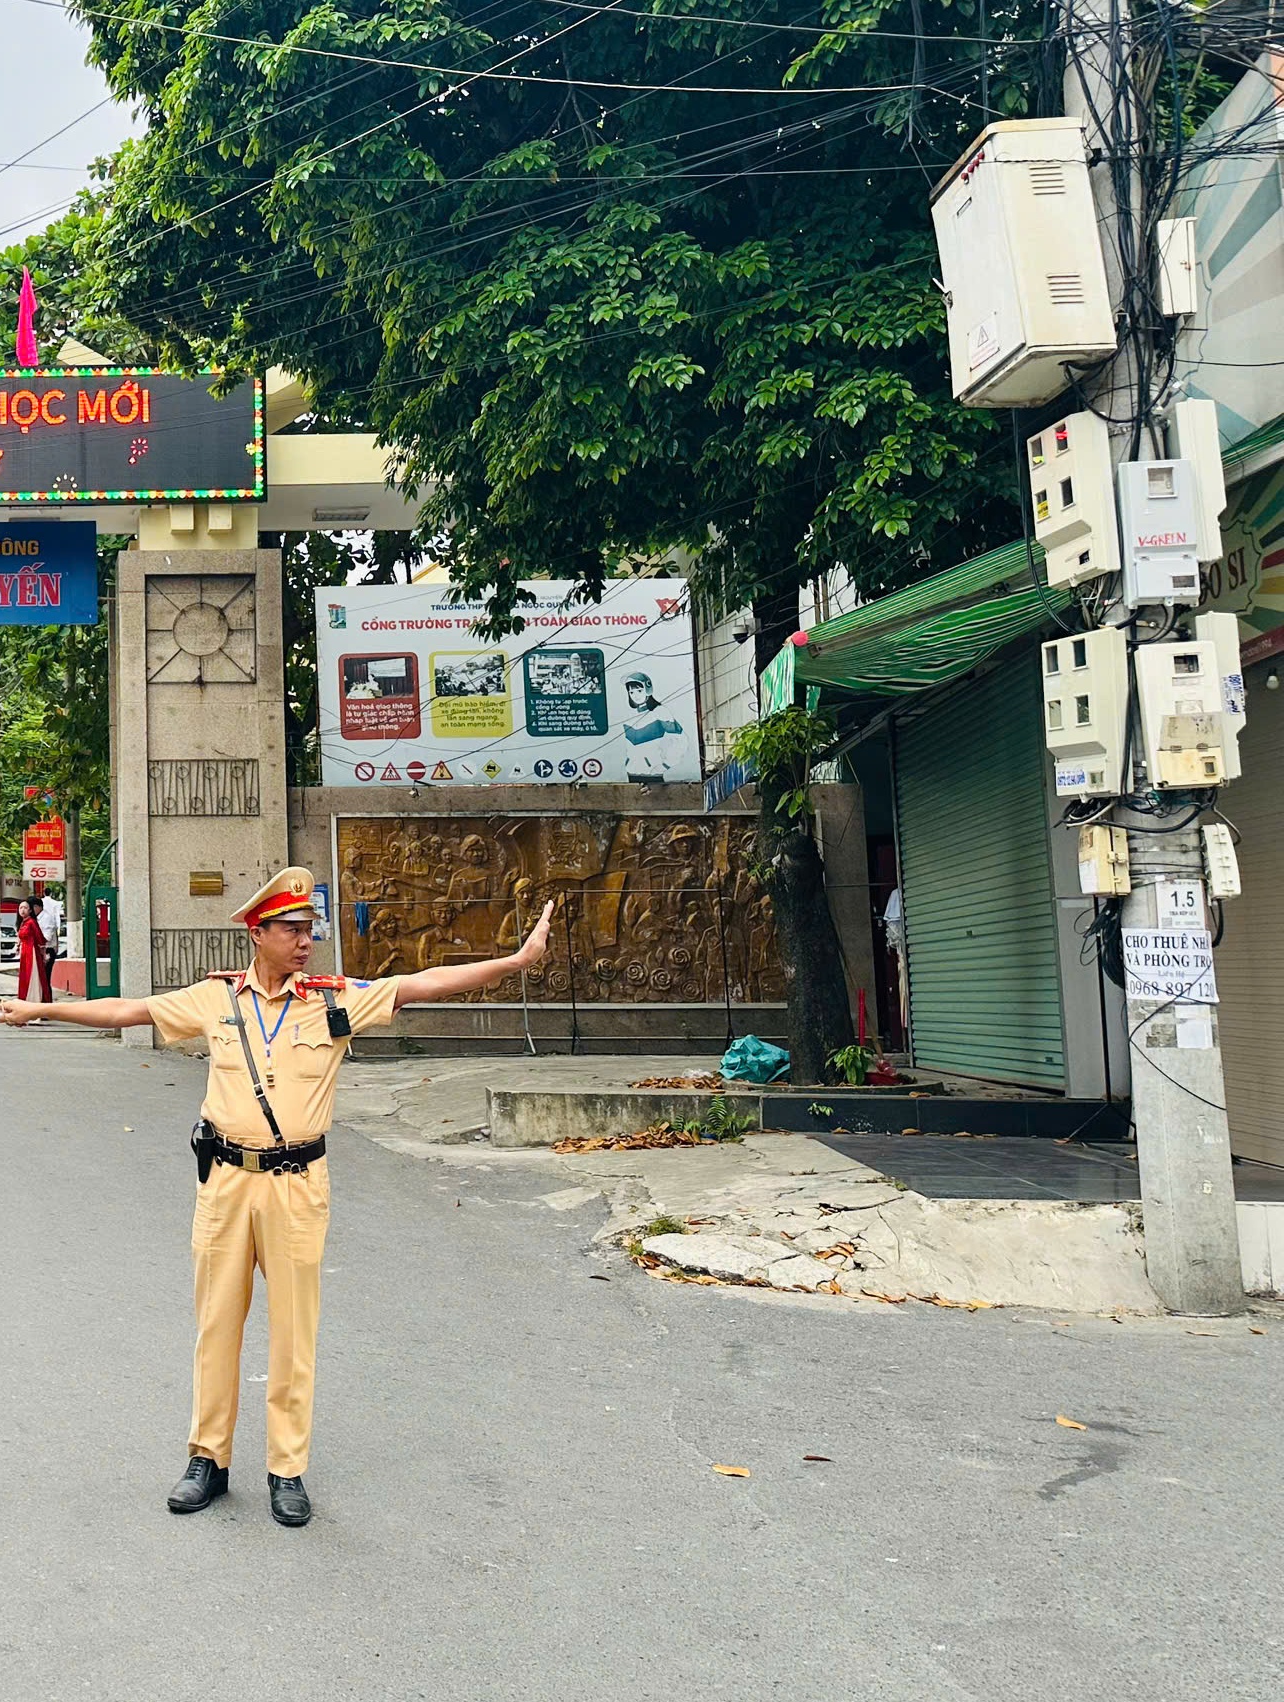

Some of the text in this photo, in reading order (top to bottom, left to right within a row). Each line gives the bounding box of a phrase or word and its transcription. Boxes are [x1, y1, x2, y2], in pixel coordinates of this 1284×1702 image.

[77, 380, 150, 424] MỚI
[361, 616, 452, 630] CỔNG TRƯỜNG
[532, 613, 648, 627] TOÀN GIAO THÔNG
[30, 867, 47, 878] 5G
[1171, 891, 1195, 907] 1.5
[1125, 933, 1189, 949] CHO THUÊ
[1126, 950, 1140, 966] VÀ
[1144, 951, 1190, 967] PHÒNG
[1129, 982, 1159, 996] 0968
[1166, 982, 1193, 997] 897
